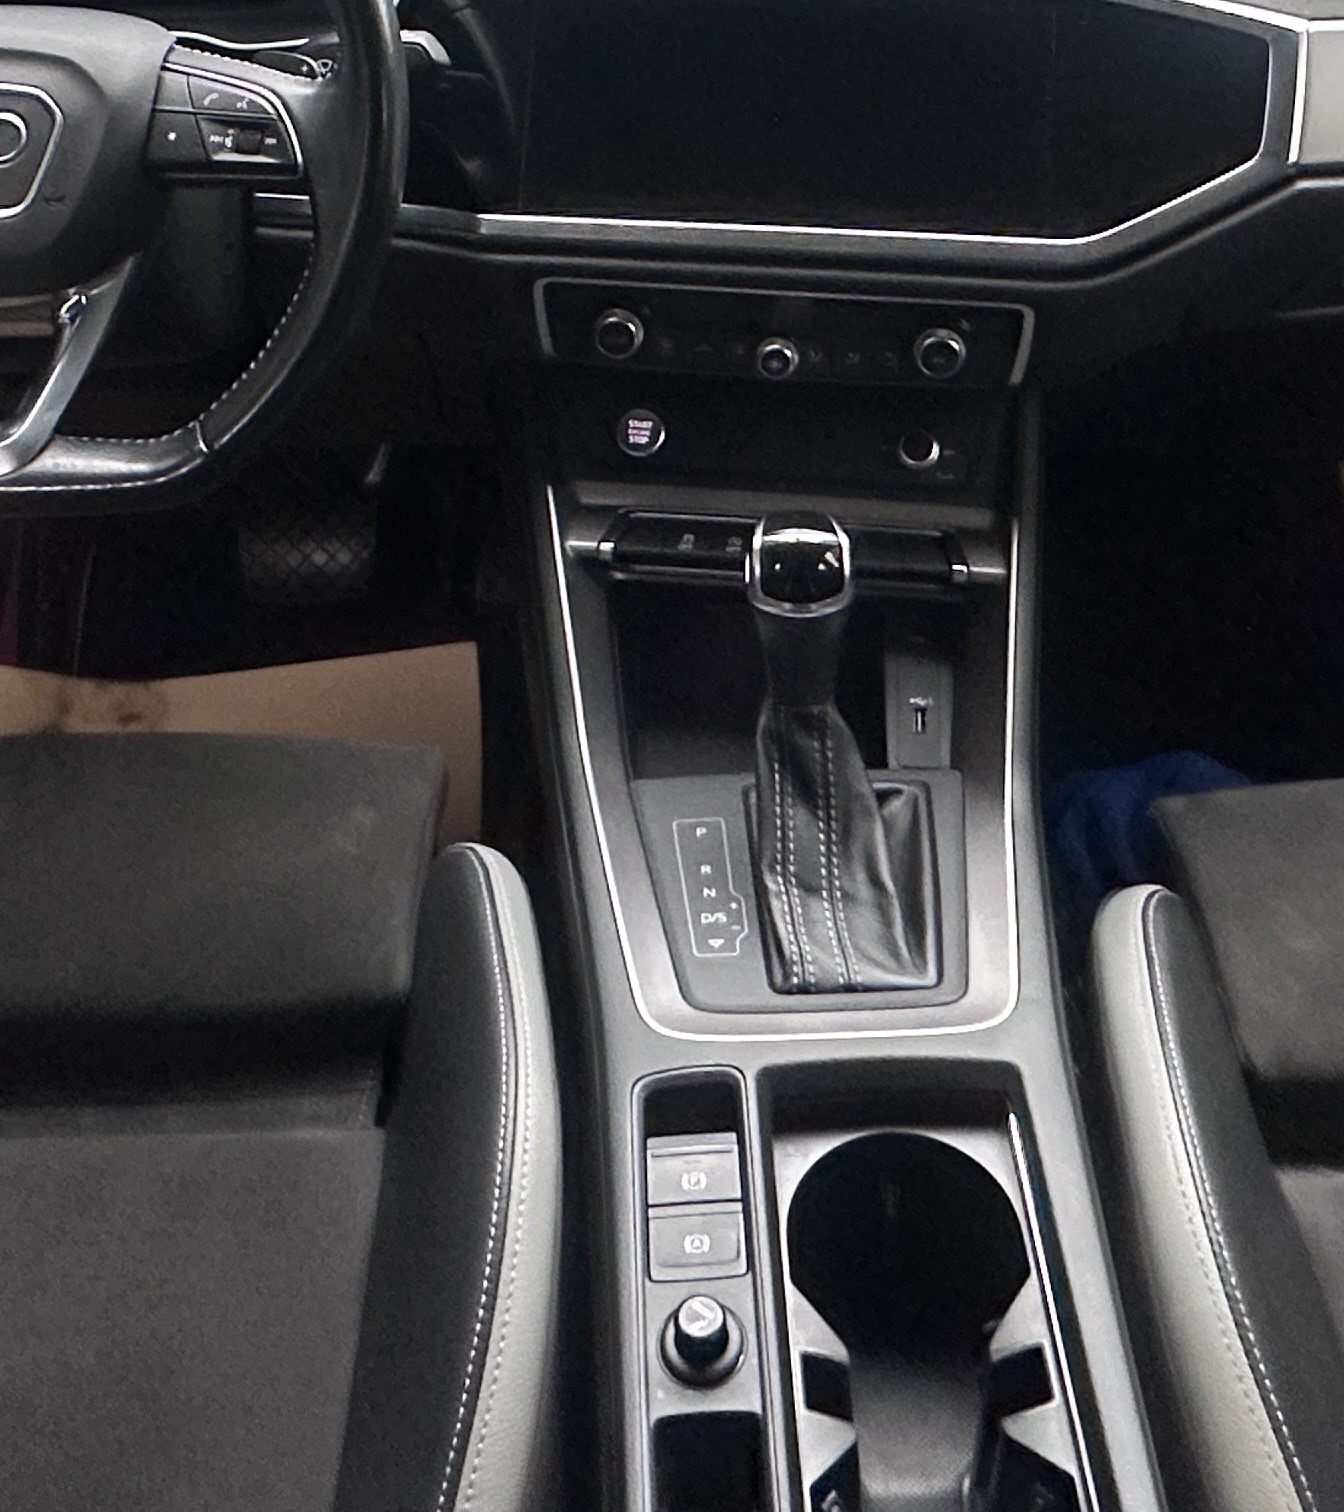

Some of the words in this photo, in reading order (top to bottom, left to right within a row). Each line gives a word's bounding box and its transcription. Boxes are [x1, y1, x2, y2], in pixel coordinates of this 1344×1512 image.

[696, 826, 708, 838] P
[700, 864, 712, 875] R
[703, 887, 716, 898] N
[700, 912, 728, 923] D/S
